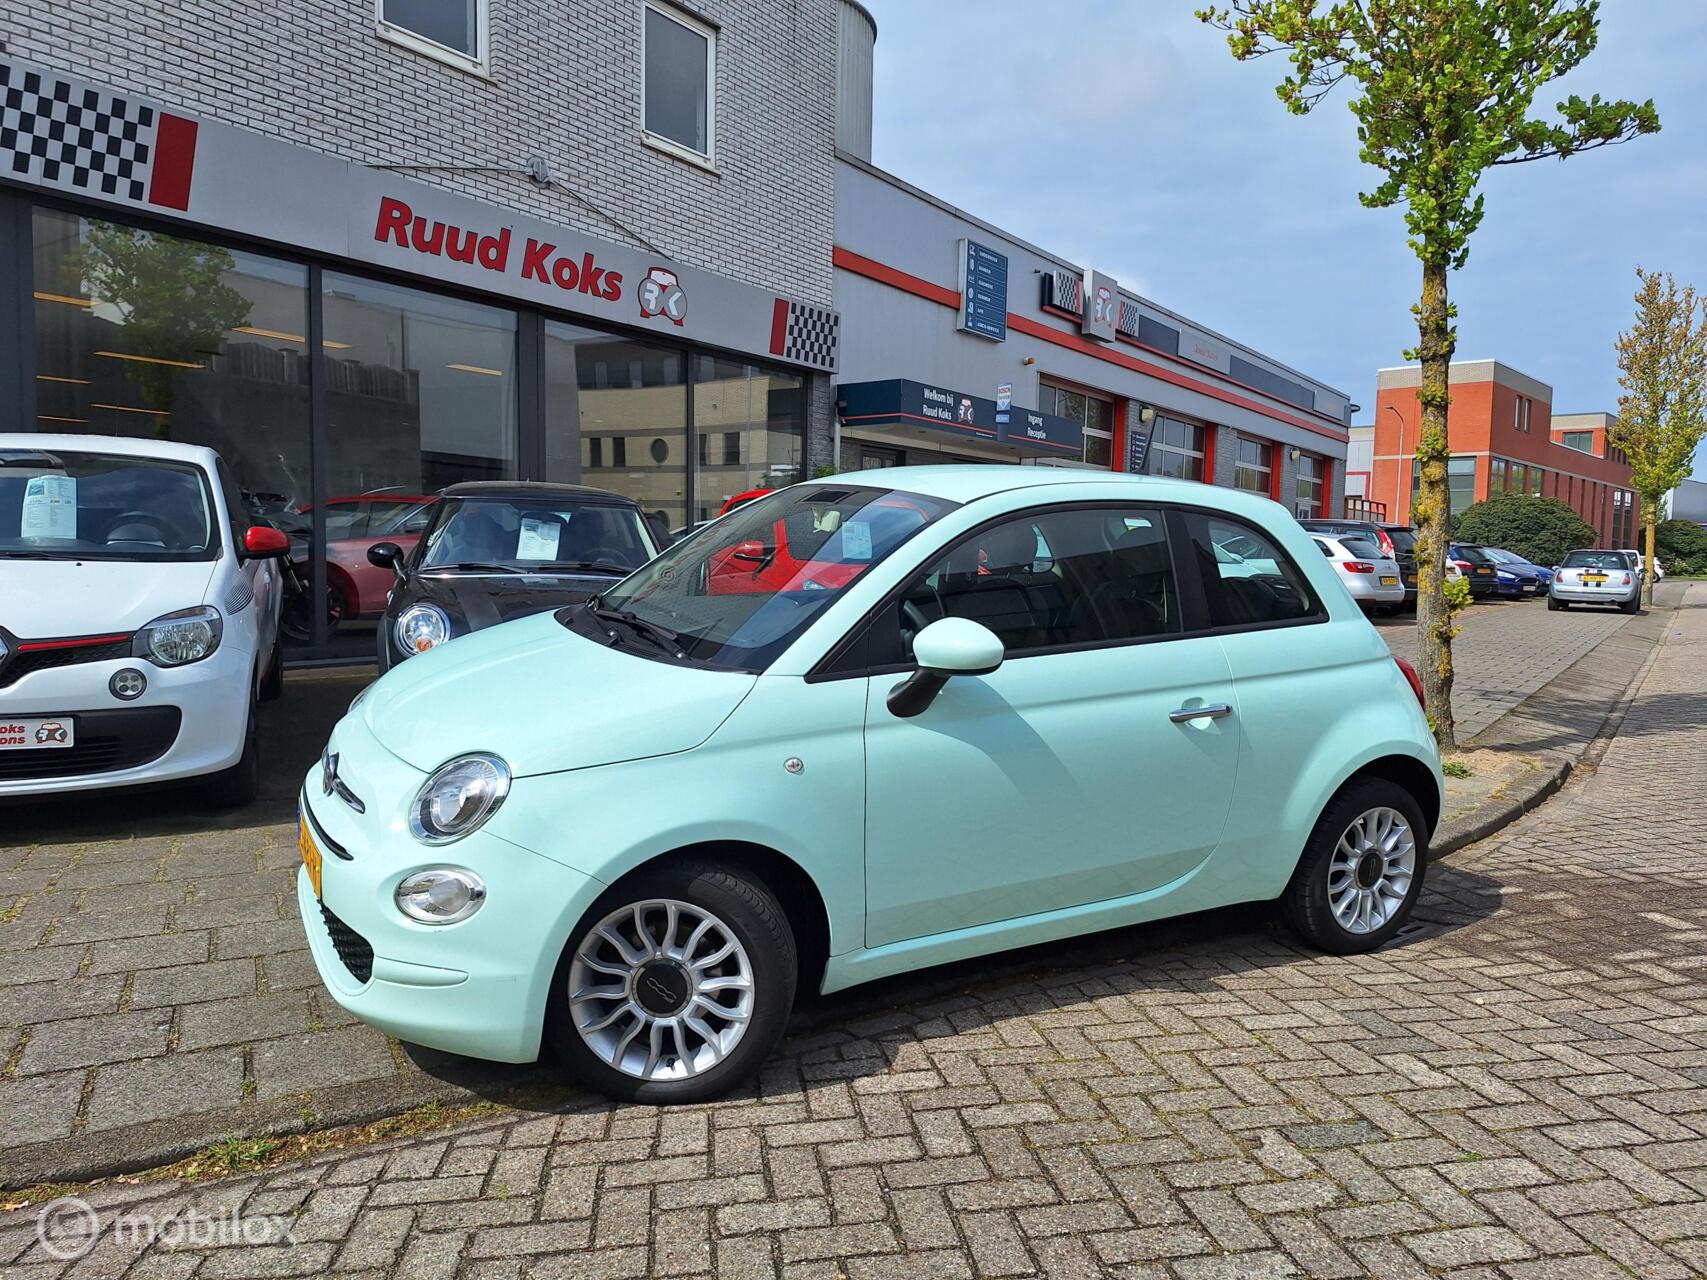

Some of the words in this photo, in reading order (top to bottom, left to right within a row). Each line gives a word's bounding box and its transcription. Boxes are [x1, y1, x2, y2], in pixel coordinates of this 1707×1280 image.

[374, 196, 512, 272] Ruud
[520, 238, 623, 302] Koks
[923, 388, 946, 403] Welkom
[946, 393, 954, 407] bij
[922, 404, 938, 417] Ruud
[938, 408, 952, 420] Koks
[1027, 413, 1043, 427] Ingang
[1027, 427, 1046, 440] Receptie
